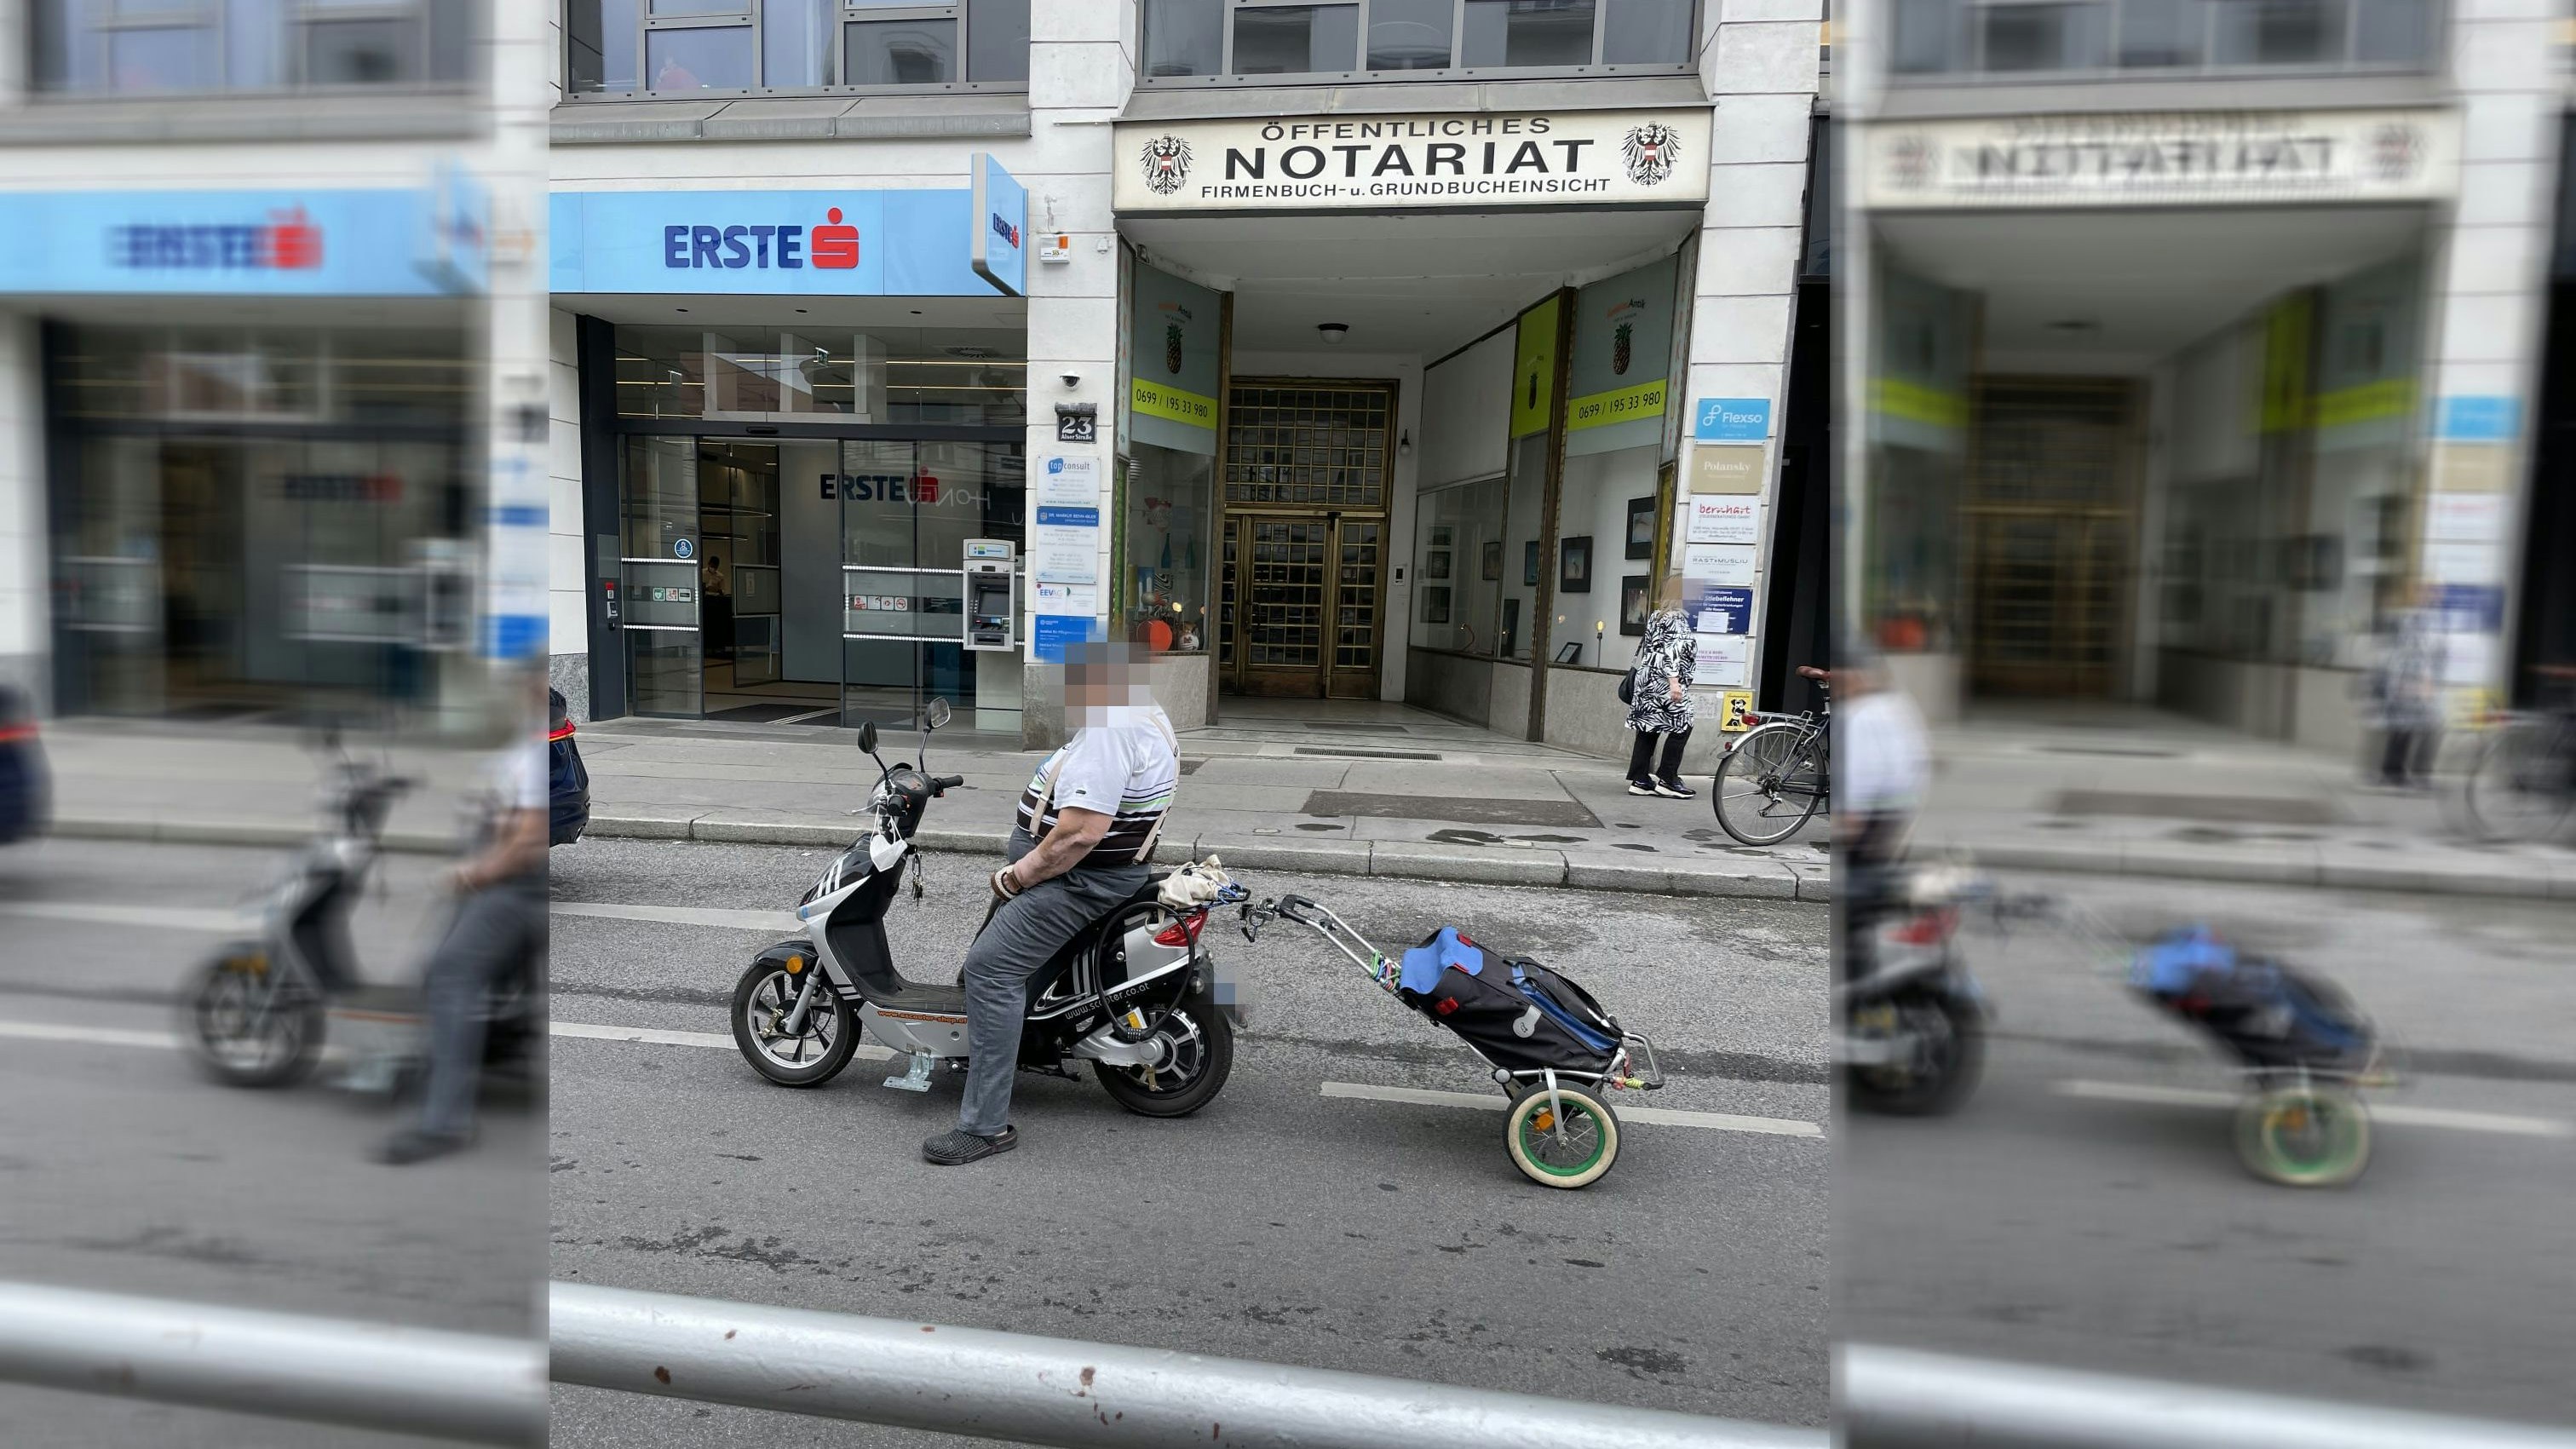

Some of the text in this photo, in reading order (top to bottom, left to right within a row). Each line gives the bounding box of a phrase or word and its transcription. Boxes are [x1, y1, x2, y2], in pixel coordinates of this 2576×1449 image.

[1262, 118, 1550, 141] ÖFFENTLICHES
[1225, 140, 1595, 181] NOTARIAT
[1201, 184, 1347, 198] FIRMENBUCH-
[1370, 178, 1611, 196] GRUNDBUCHEINSICHT
[993, 212, 1012, 244] ERSTE
[664, 225, 803, 268] ERSTE
[1136, 388, 1157, 405] 0699
[1166, 396, 1179, 411] 195
[1182, 400, 1191, 413] 33
[1194, 403, 1208, 417] 980
[1578, 403, 1600, 419] 0699
[1610, 398, 1624, 413] 195
[1629, 395, 1639, 409] 33
[1643, 391, 1660, 406] 980
[1061, 416, 1092, 435] 23
[1722, 412, 1762, 423] Flexso
[1704, 461, 1751, 474] Polansky
[820, 474, 905, 502] ERSTE
